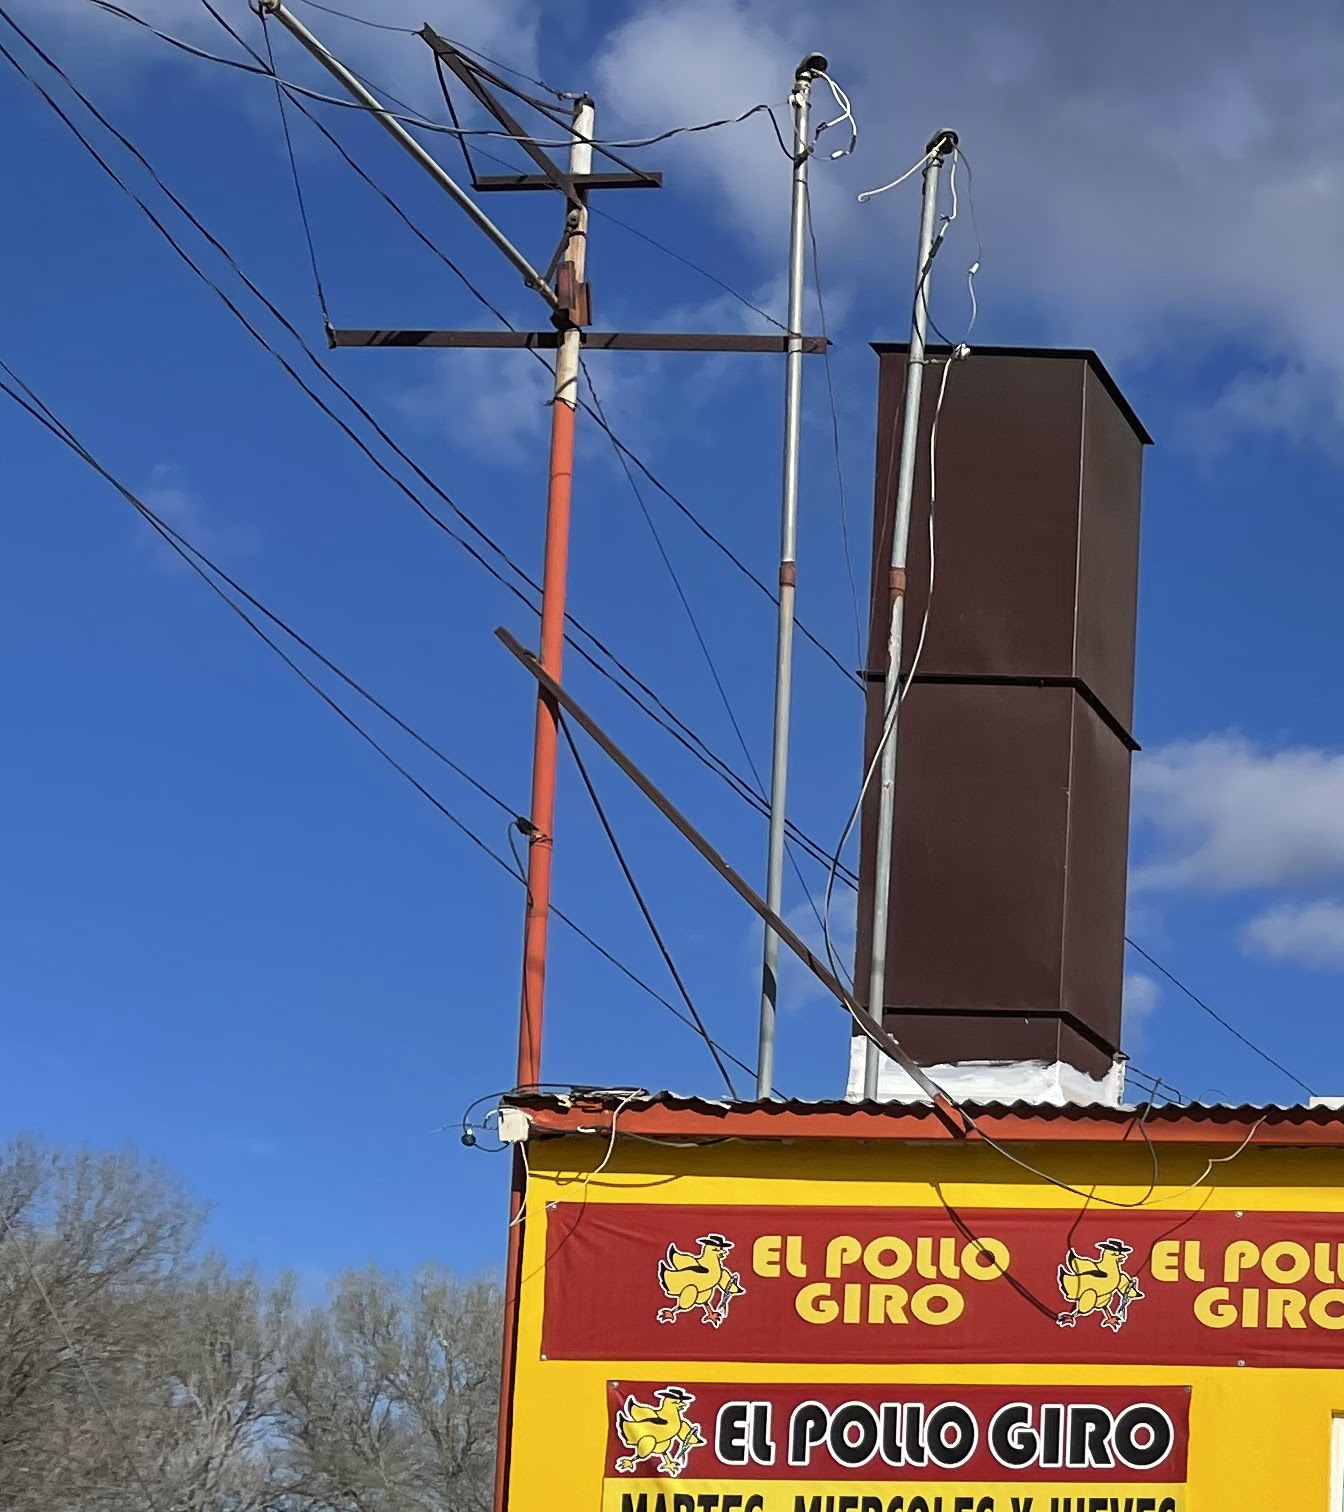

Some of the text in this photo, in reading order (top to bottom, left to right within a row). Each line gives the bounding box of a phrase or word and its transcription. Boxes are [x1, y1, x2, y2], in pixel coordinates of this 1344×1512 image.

[753, 1236, 1010, 1280] EL POLLO
[1151, 1241, 1205, 1282] EL
[796, 1283, 964, 1325] GIRO
[716, 1402, 1176, 1469] EL POLLO GIRO
